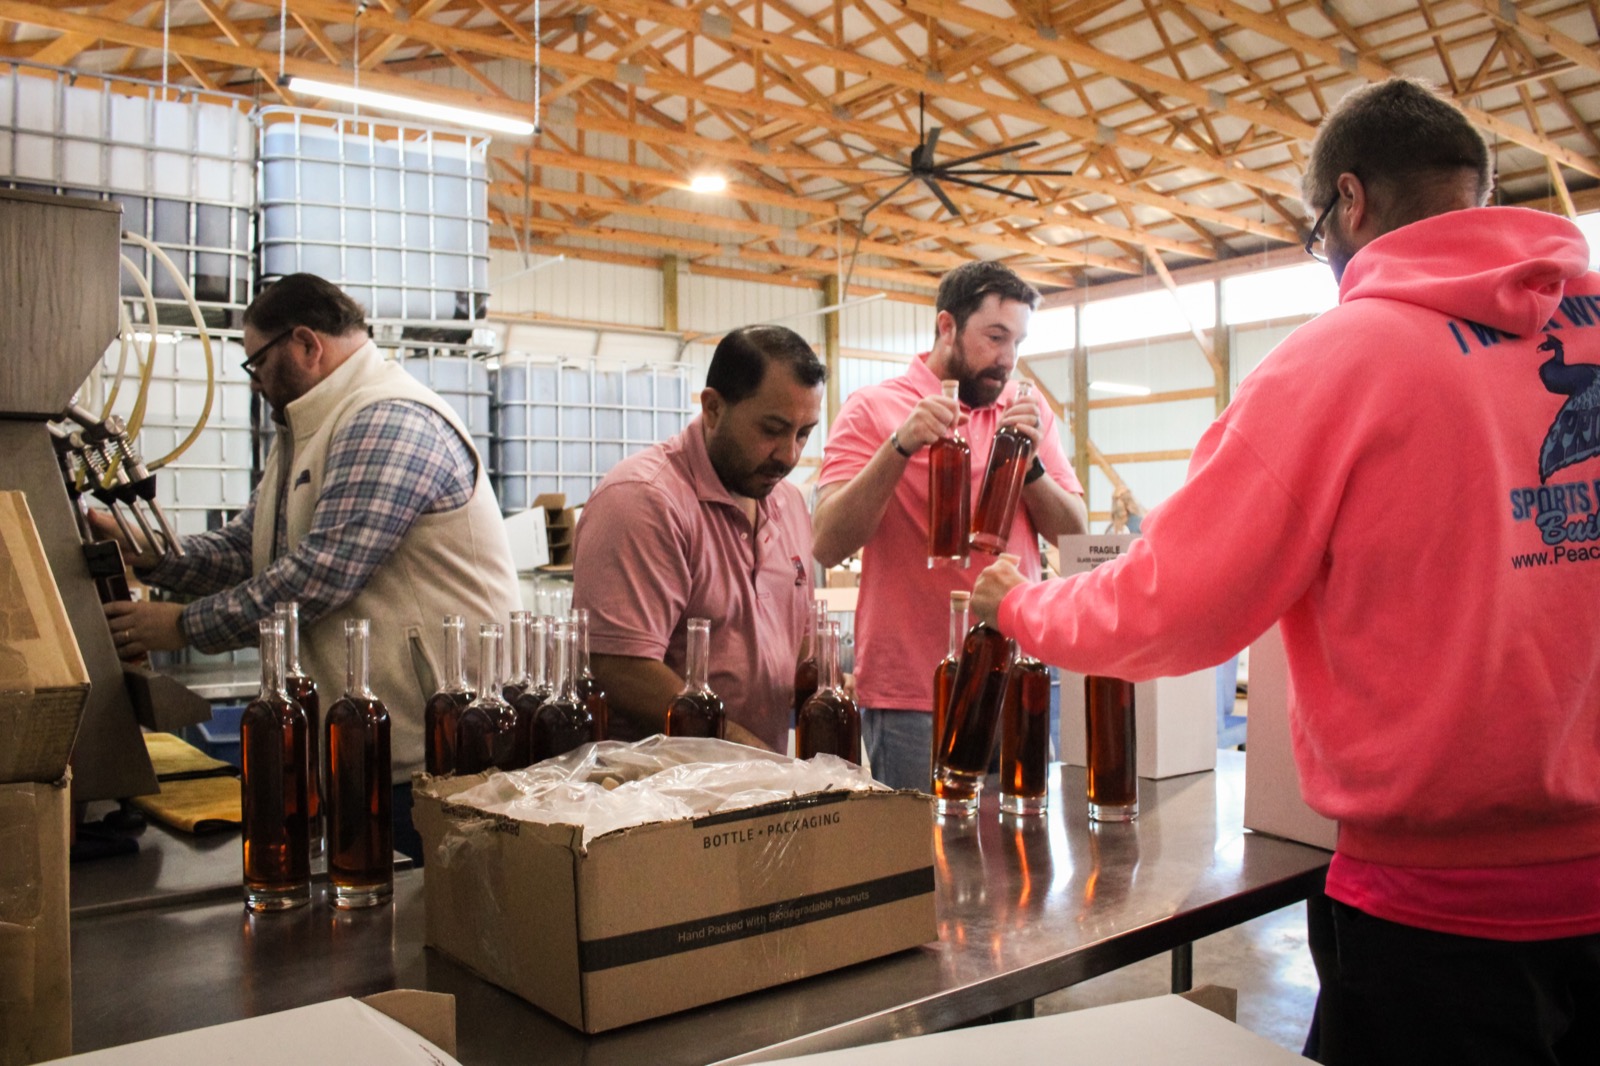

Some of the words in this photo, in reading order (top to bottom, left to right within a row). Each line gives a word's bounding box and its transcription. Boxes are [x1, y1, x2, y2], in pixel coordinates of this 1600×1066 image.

[1510, 481, 1592, 521] SPORTS
[1089, 545, 1120, 555] FRAGILE
[703, 828, 754, 849] BOTTLE
[767, 811, 840, 837] PACKAGING
[678, 927, 705, 943] Hand
[707, 919, 744, 936] Packed
[768, 900, 833, 923] Biodegradable
[834, 890, 870, 907] Peanuts
